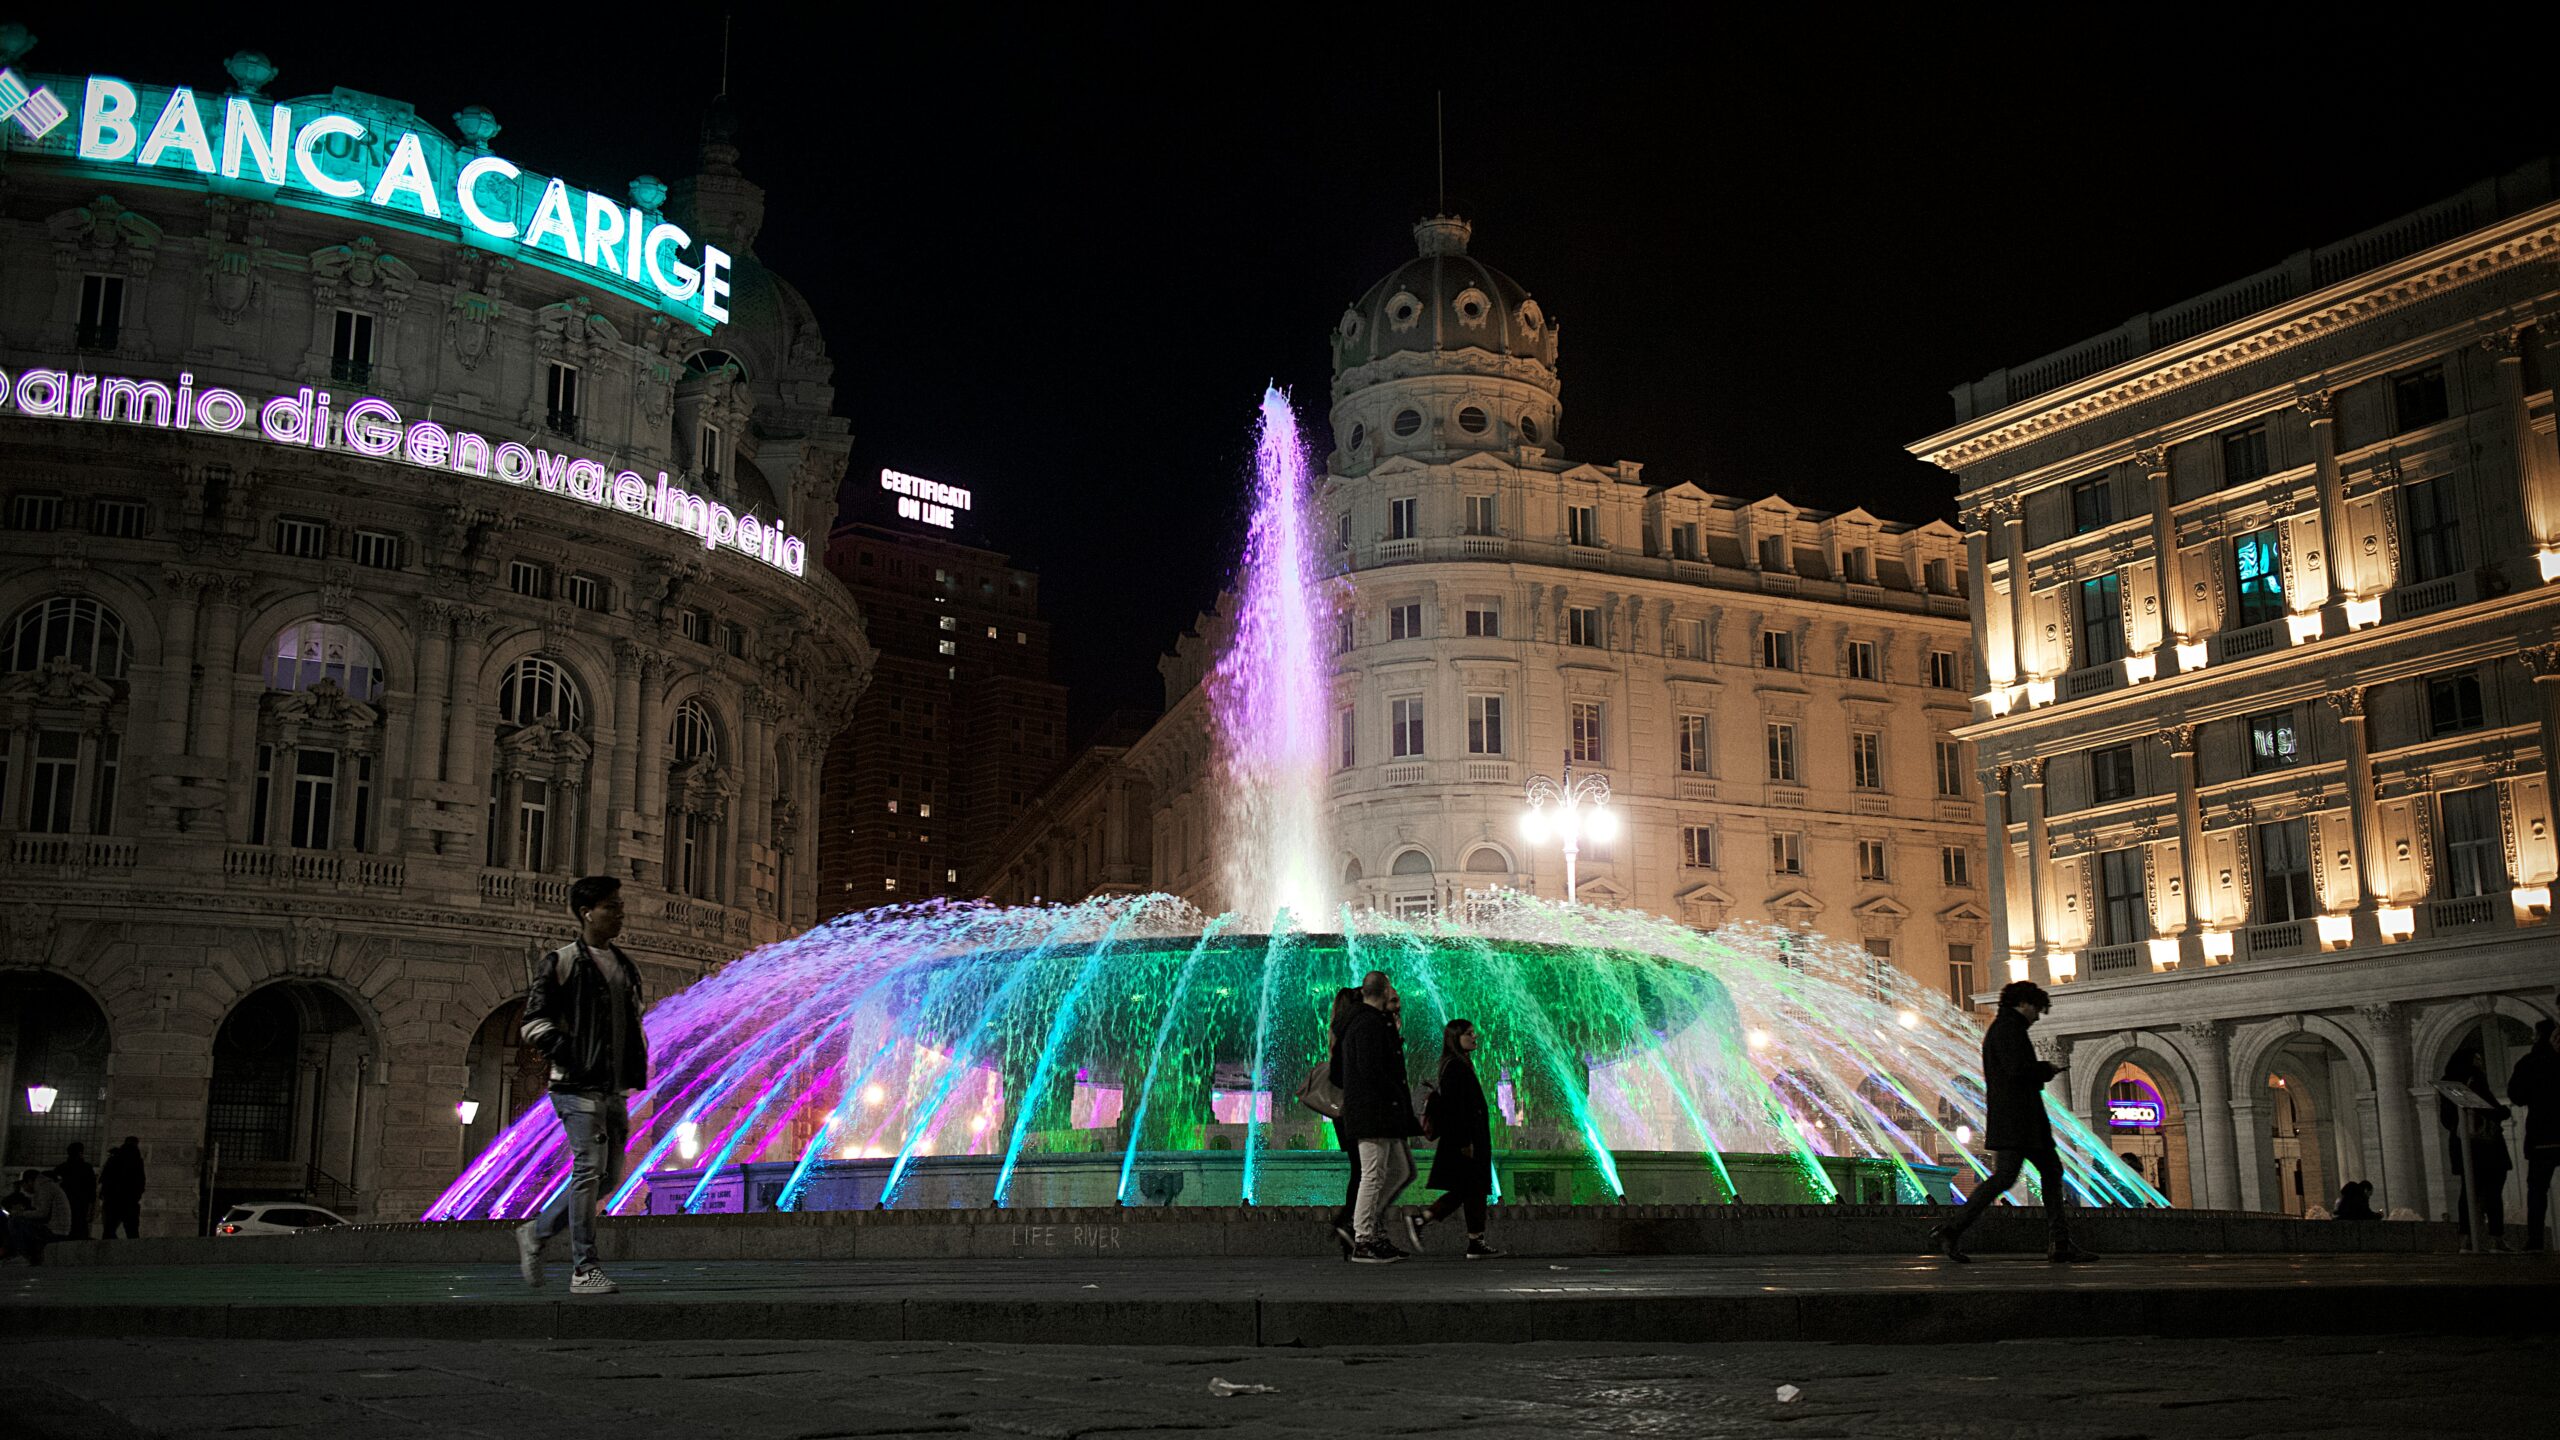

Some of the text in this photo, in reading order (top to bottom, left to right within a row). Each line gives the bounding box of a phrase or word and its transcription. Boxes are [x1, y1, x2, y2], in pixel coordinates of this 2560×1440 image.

[79, 76, 731, 324] BANCA CARIGE
[262, 387, 330, 449] di
[344, 397, 605, 503] Genova
[613, 470, 648, 512] e
[654, 471, 805, 577] Imperia
[881, 468, 971, 511] CERTIFICATI
[898, 496, 955, 529] ON LINE
[1012, 1224, 1120, 1249] LIFE RIVER
